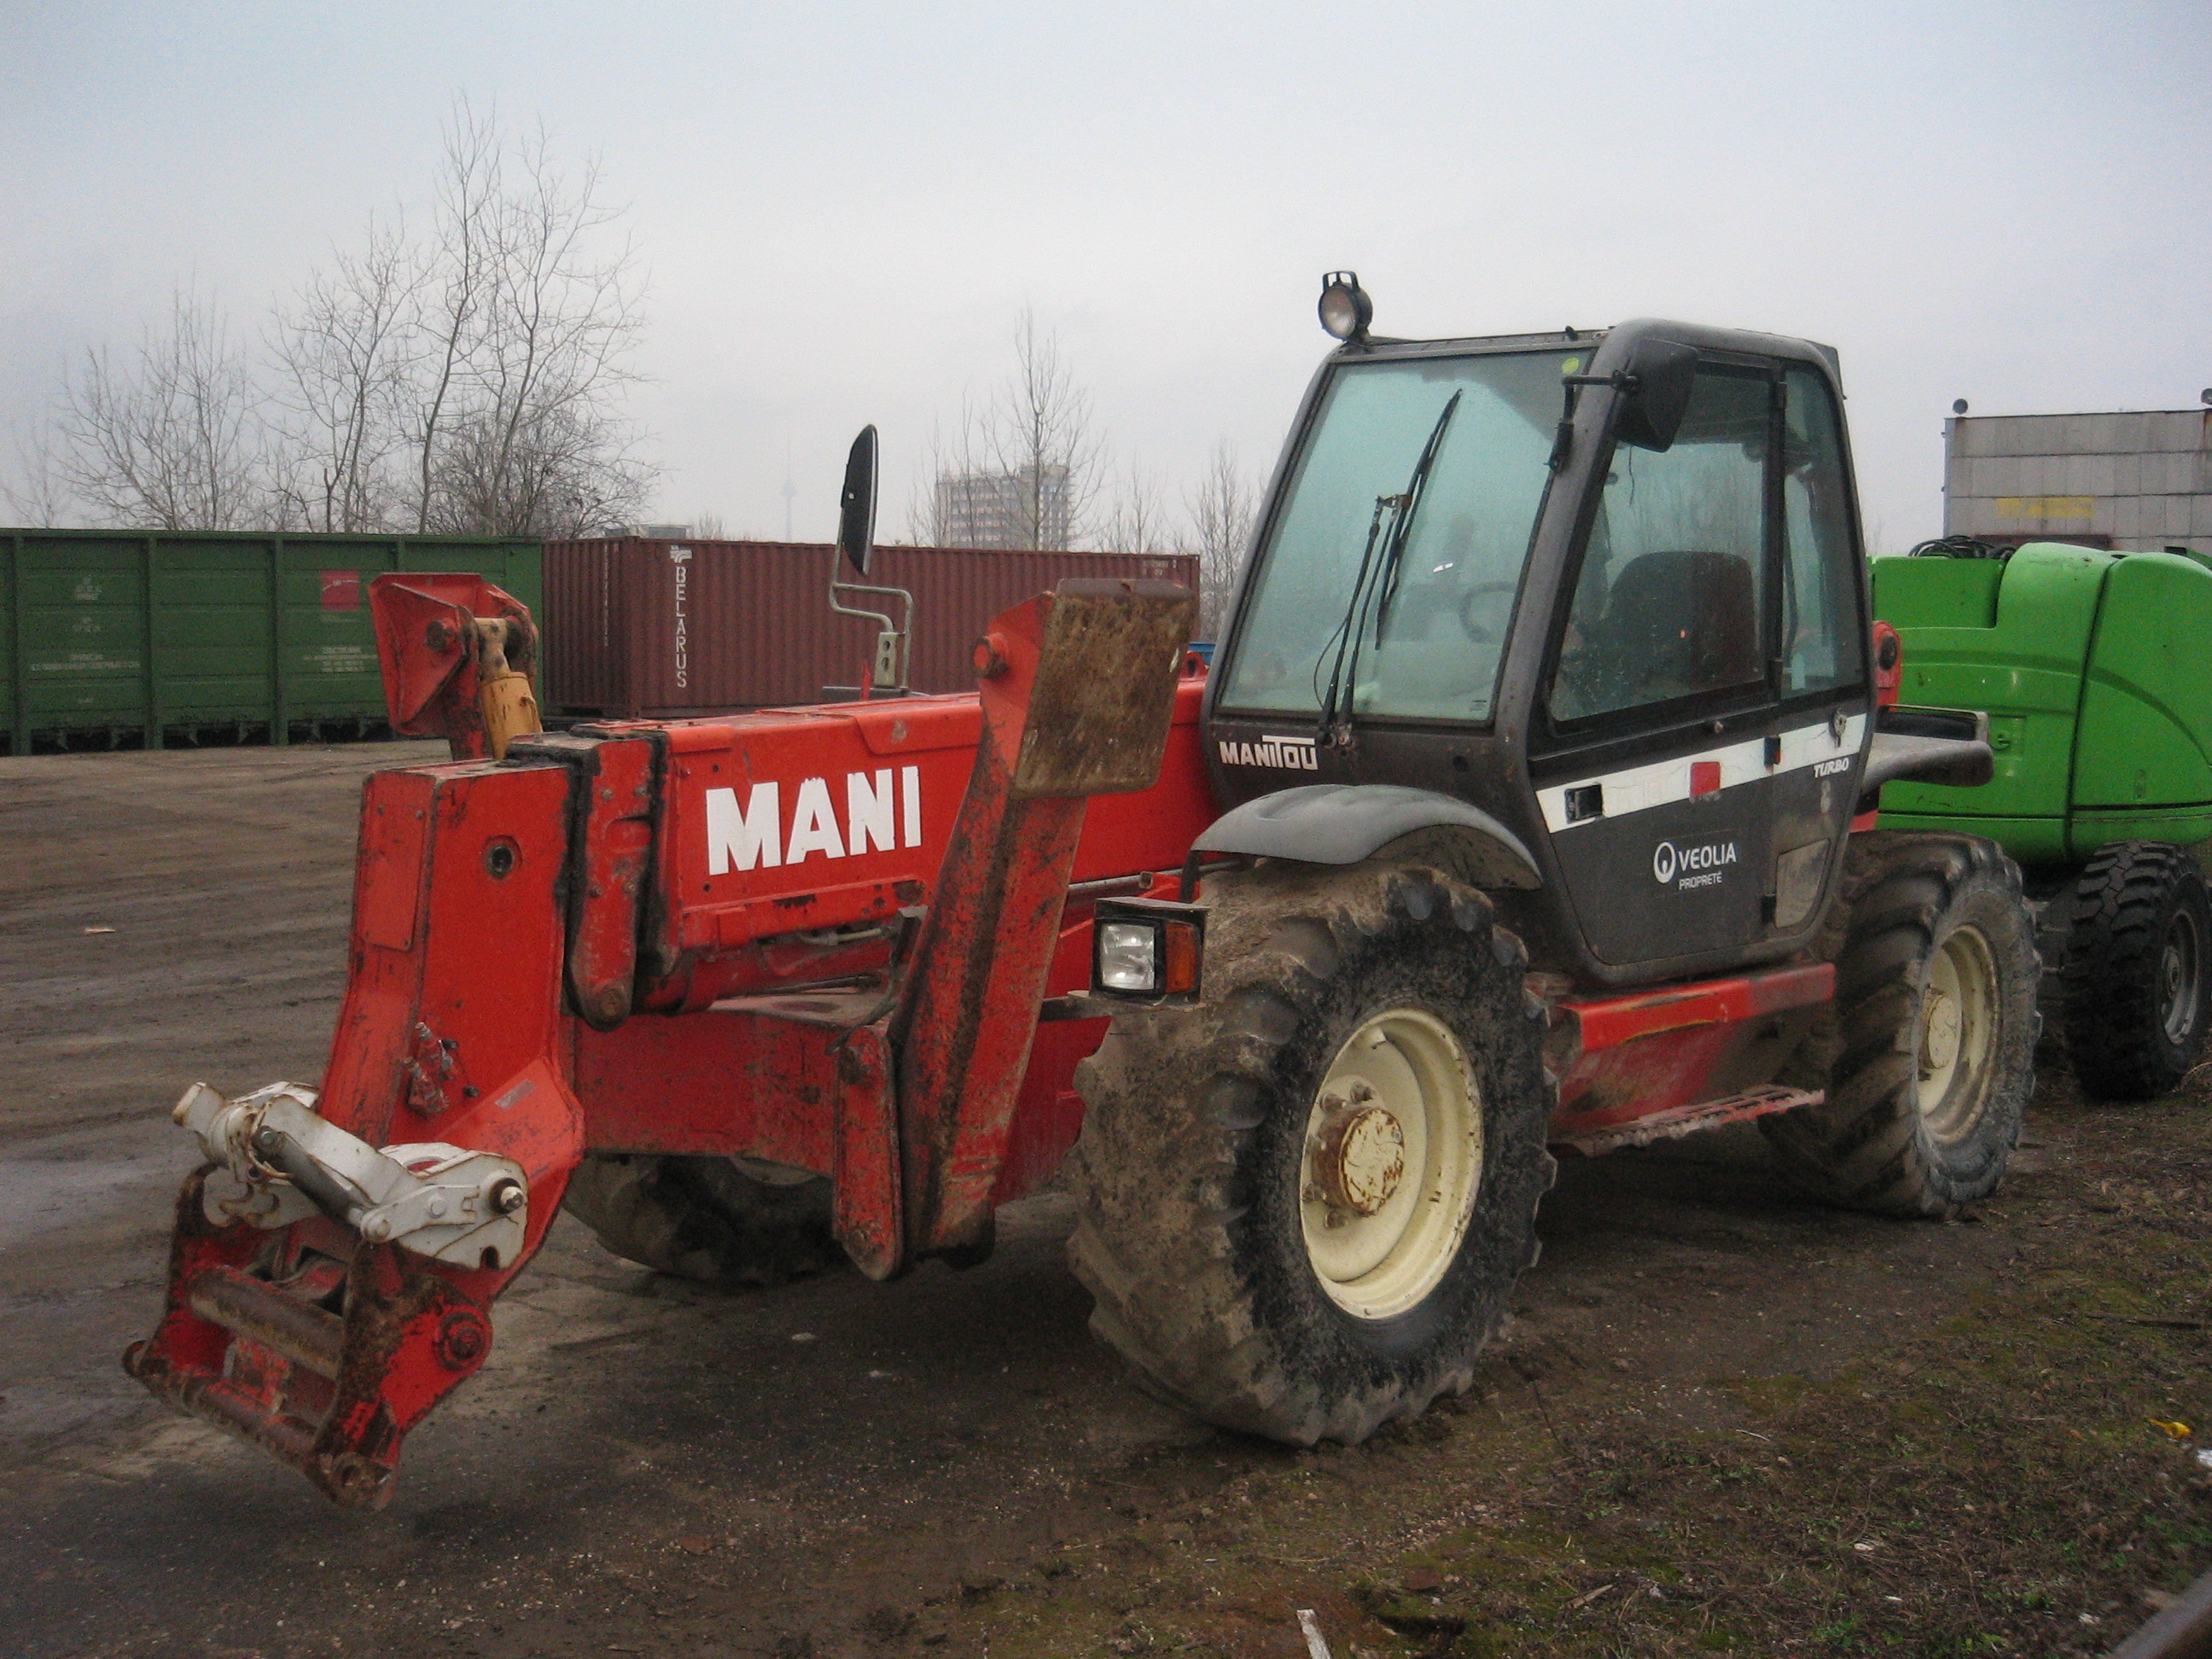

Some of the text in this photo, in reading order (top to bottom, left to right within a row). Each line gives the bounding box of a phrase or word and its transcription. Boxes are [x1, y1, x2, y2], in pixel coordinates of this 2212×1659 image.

[675, 566, 688, 688] BELARUS
[1220, 735, 1318, 771] MANITOU
[1813, 757, 1849, 778] TURBO
[706, 765, 922, 876] MANI
[1678, 842, 1737, 871] VEOLIA
[1679, 870, 1722, 890] PROPRETÉ
